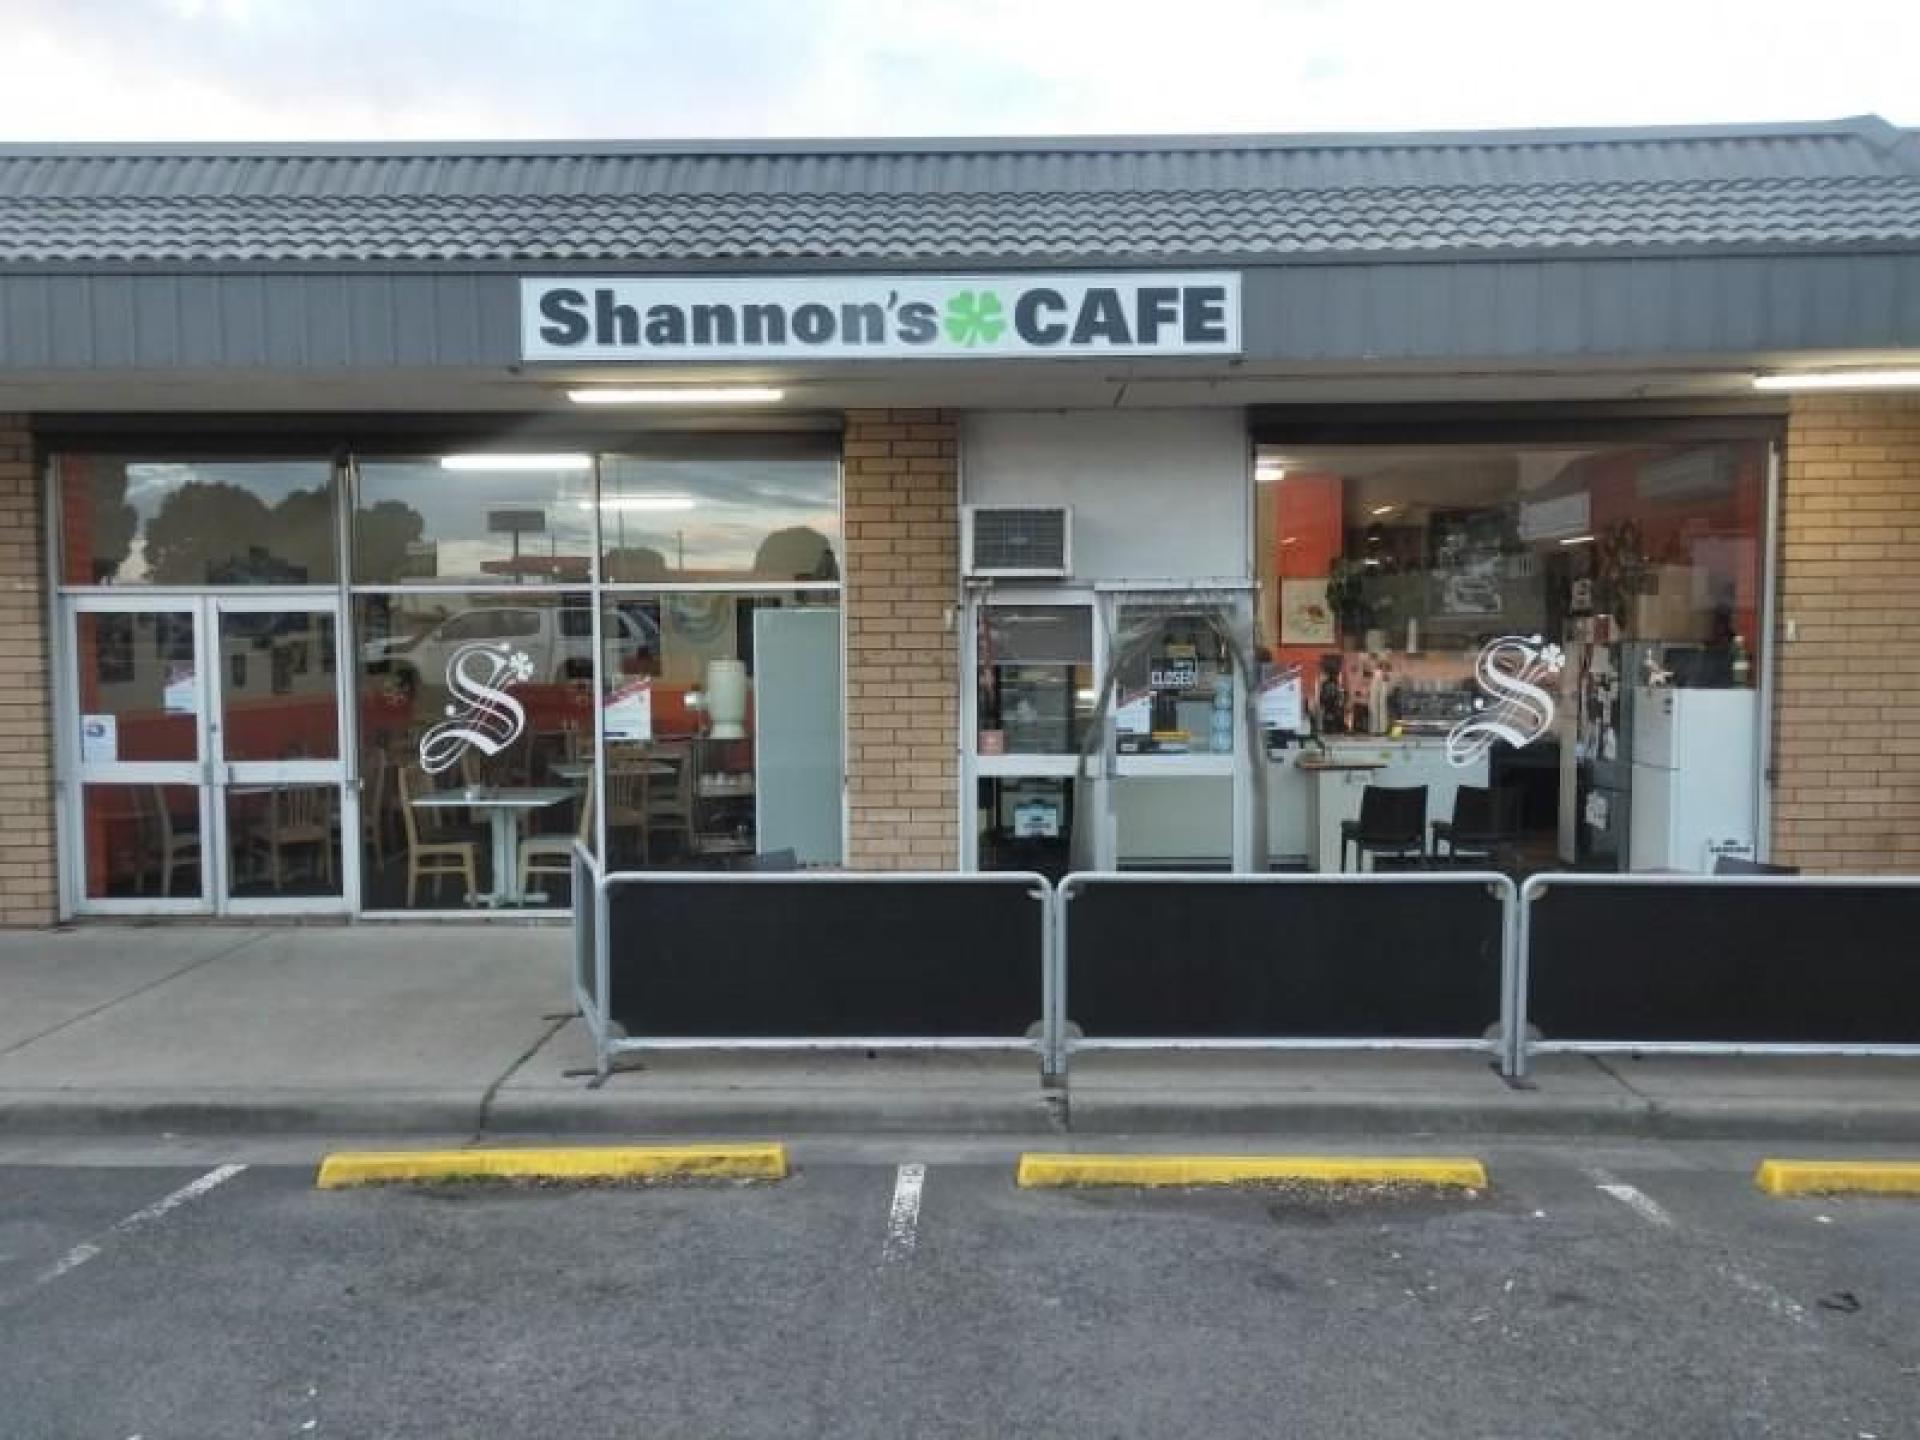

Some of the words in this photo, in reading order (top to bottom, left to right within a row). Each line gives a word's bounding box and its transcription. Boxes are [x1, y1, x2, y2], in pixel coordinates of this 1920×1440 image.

[539, 287, 939, 346] Shannon's
[1014, 286, 1227, 346] CAFE
[419, 641, 533, 773] S
[1151, 671, 1195, 686] CLOSED
[1447, 633, 1565, 768] S
